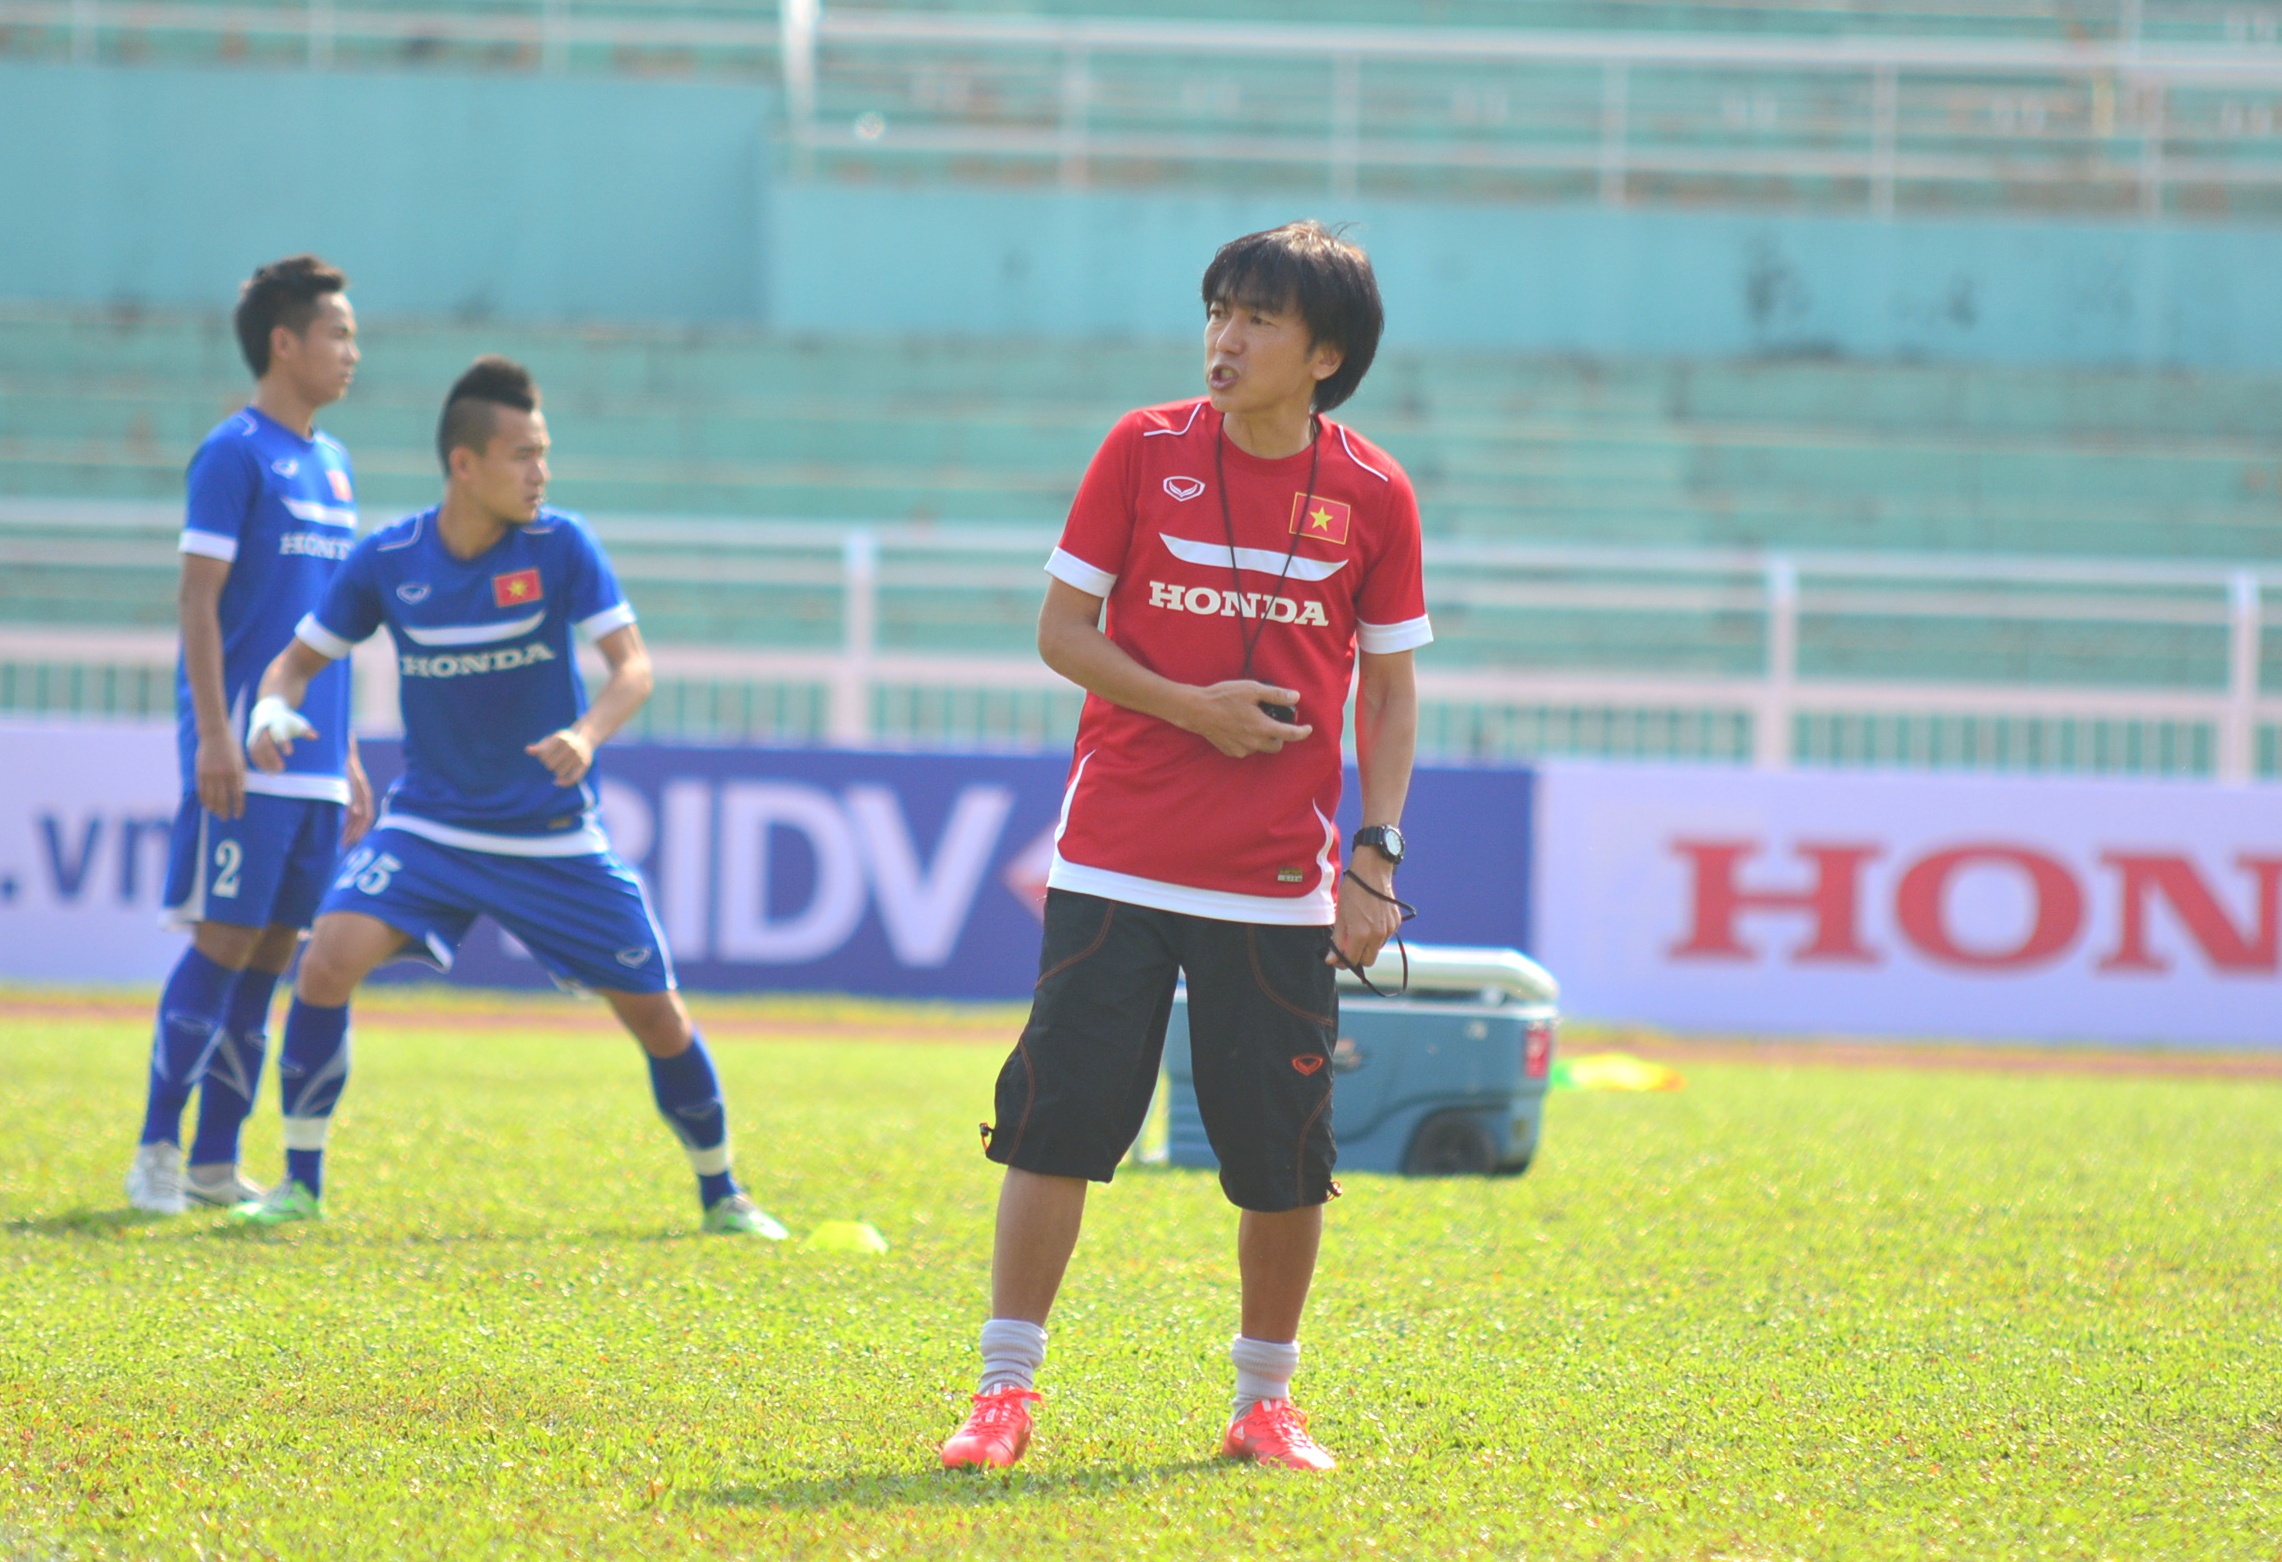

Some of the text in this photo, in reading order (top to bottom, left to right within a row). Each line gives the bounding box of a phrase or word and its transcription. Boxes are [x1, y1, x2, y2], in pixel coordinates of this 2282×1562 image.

[1149, 580, 1329, 627] HONDA
[401, 642, 555, 678] HONDA
[212, 839, 242, 898] 2
[333, 847, 402, 895] 25
